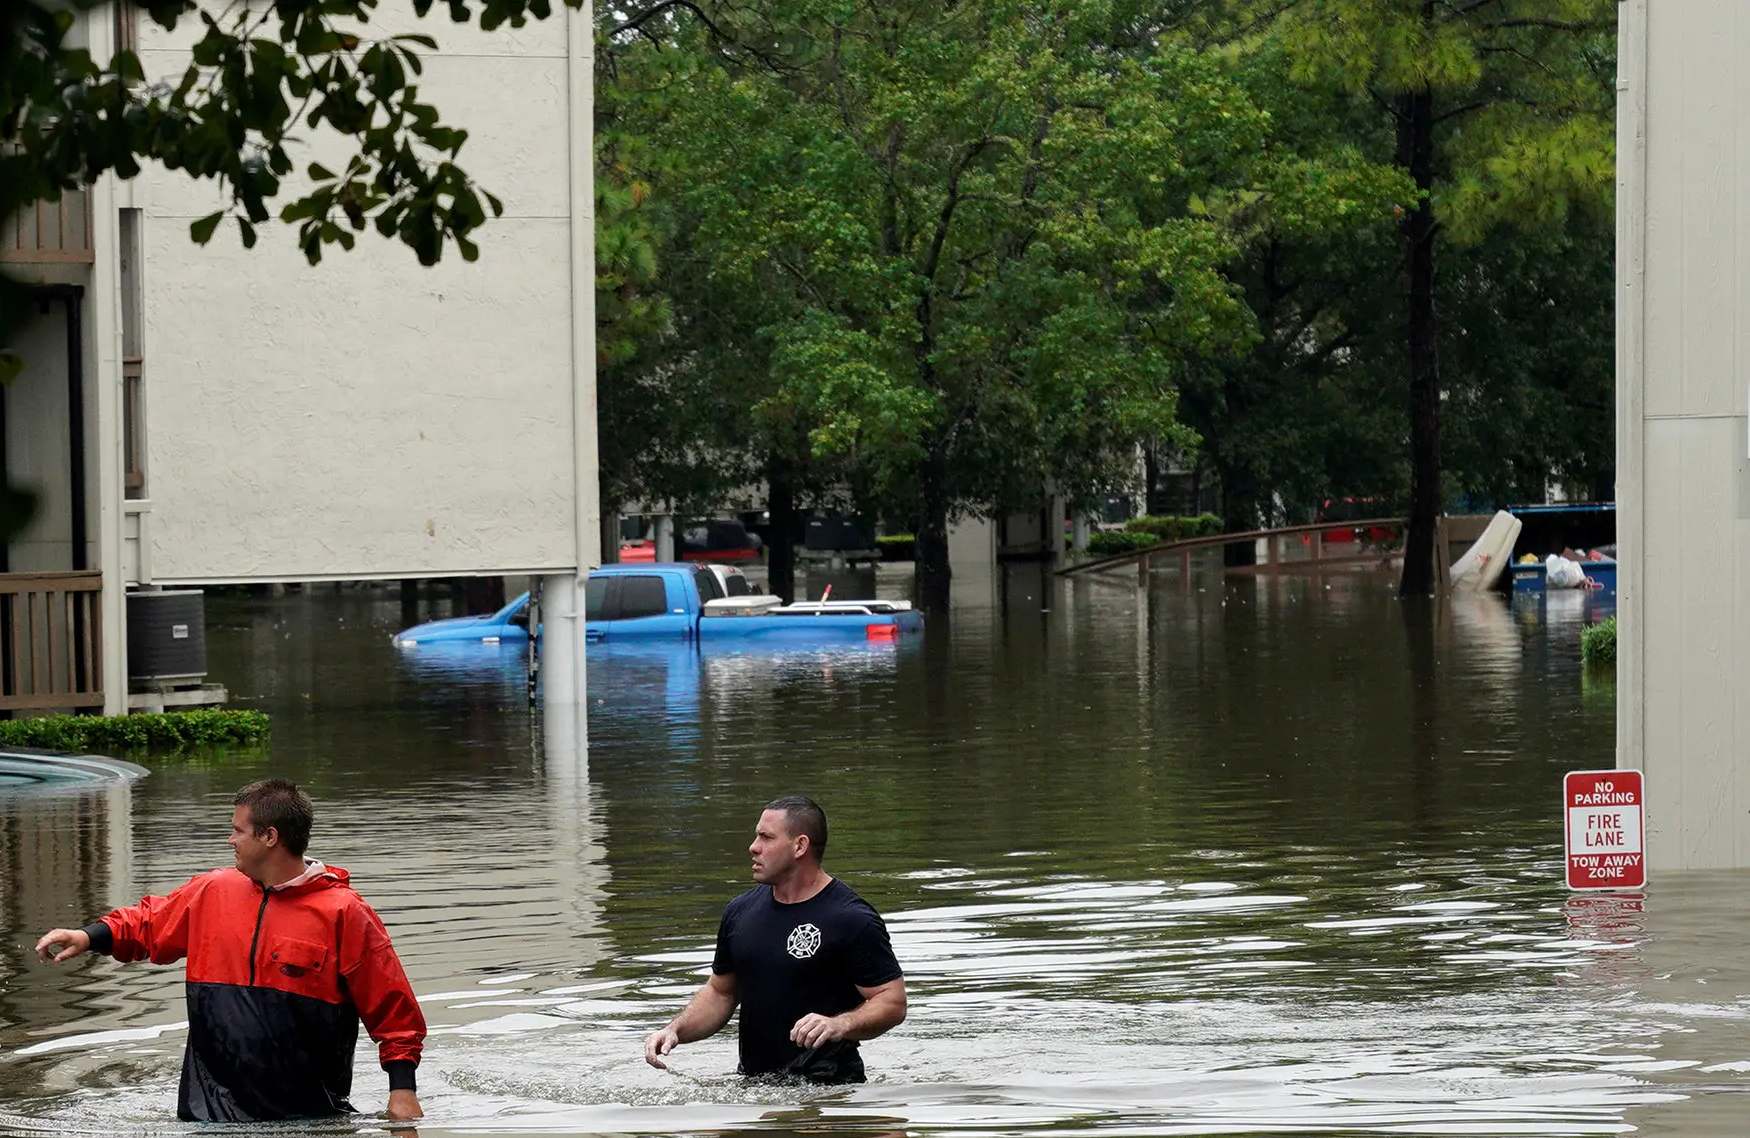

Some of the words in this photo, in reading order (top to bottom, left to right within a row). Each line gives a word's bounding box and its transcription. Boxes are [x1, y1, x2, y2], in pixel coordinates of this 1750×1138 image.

[1595, 782, 1614, 792] NO
[1575, 792, 1634, 804] PARKING
[1588, 814, 1621, 829] FIRE
[1586, 831, 1624, 846] LANE
[1572, 857, 1599, 867] TOW
[1604, 855, 1641, 867] AWAY
[1588, 867, 1624, 878] ZONE
